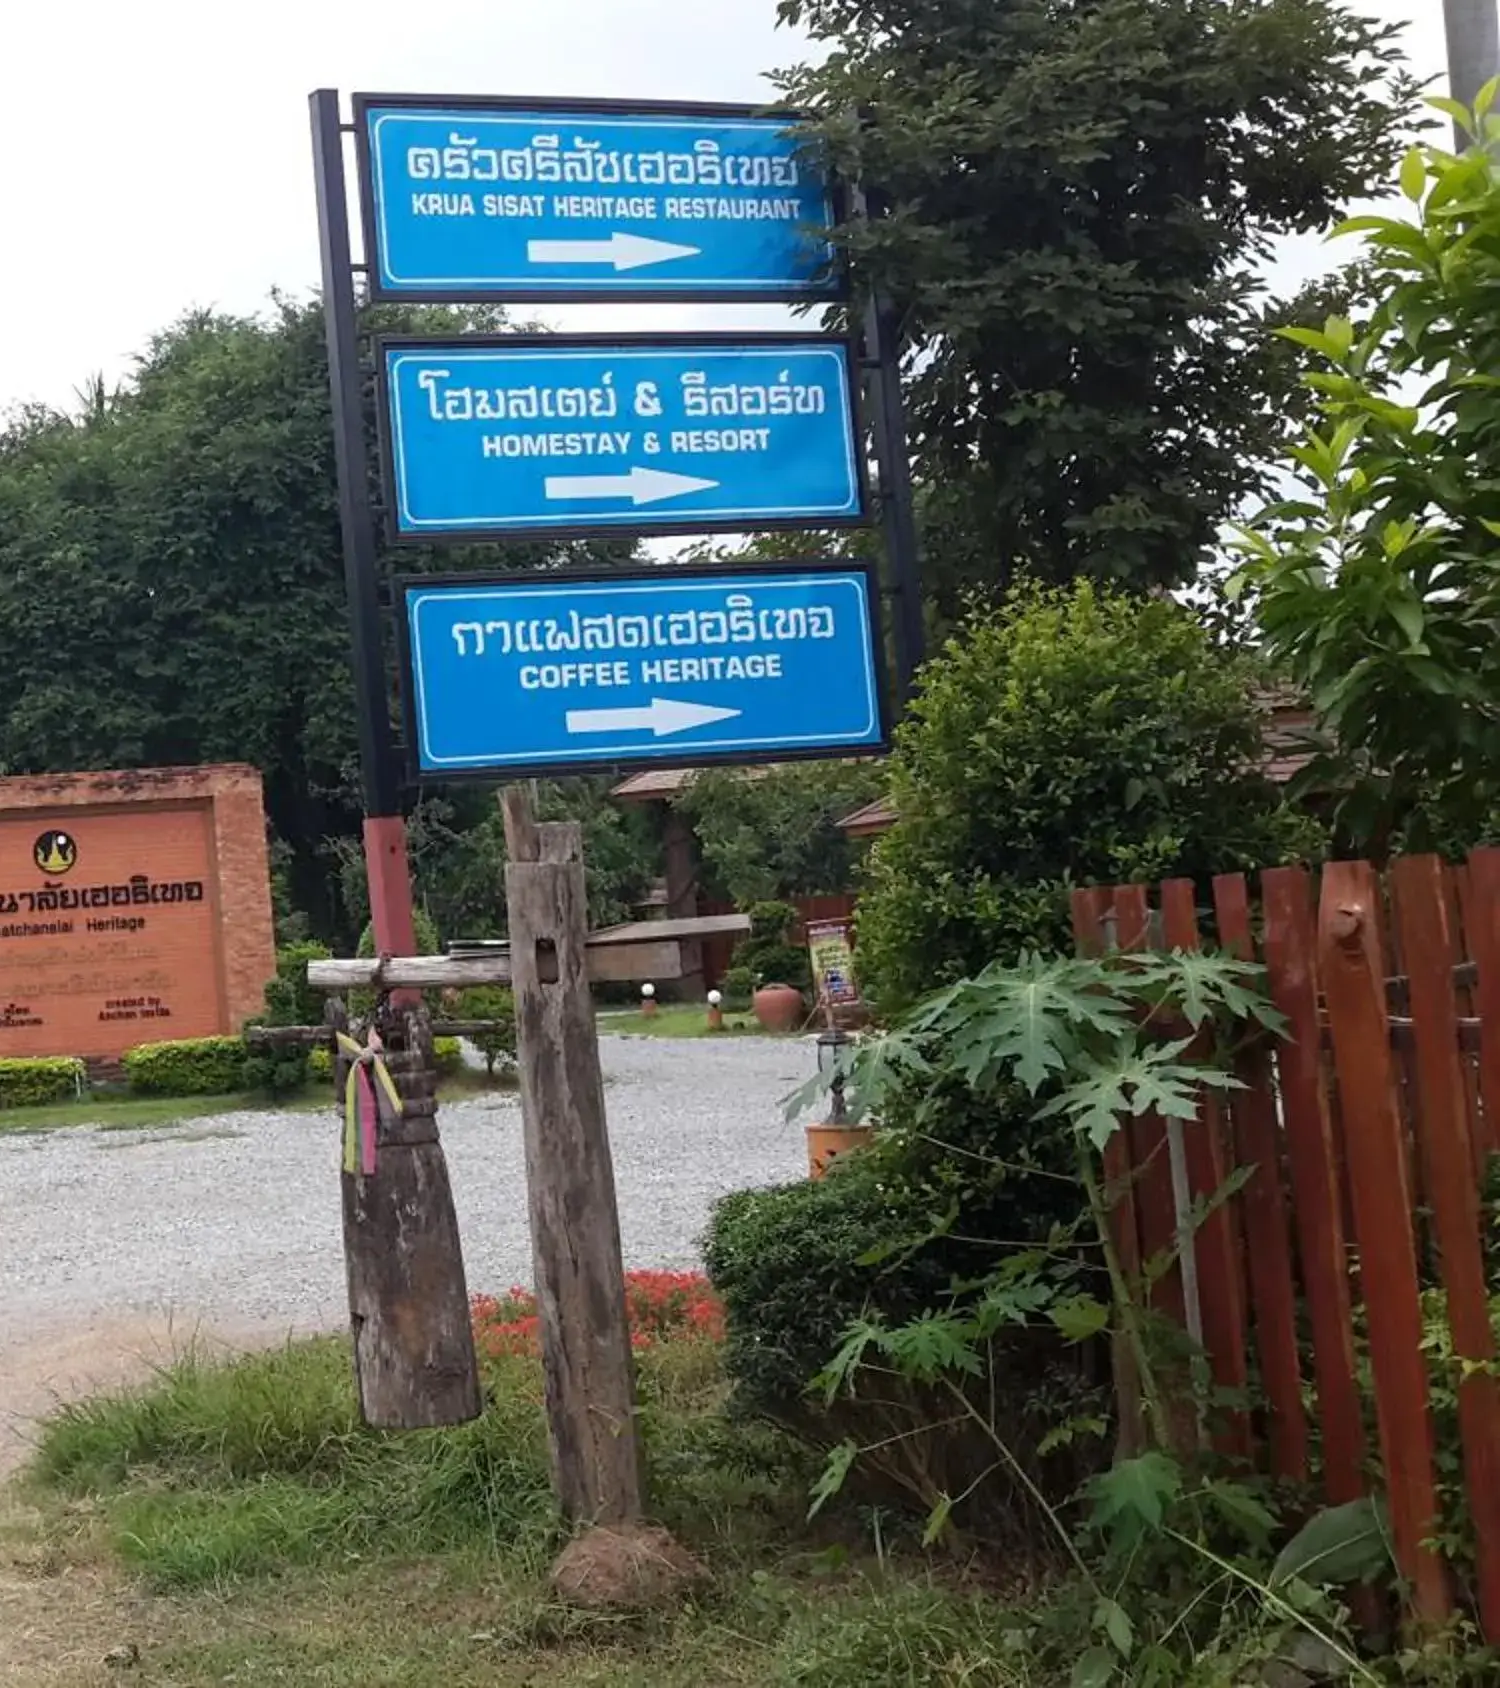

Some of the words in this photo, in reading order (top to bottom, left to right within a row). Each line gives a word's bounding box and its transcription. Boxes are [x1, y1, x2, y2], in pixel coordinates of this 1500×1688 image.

[412, 194, 475, 216] KRUA
[483, 194, 545, 217] SISAT
[554, 195, 657, 219] HERITAGE
[666, 196, 801, 220] RESTAURANT
[418, 369, 617, 421] โฮมสเตย์
[635, 381, 663, 417] &
[681, 369, 825, 416] รีสอร์ท
[482, 431, 631, 458] HOMESTAY
[643, 431, 661, 454] &
[671, 428, 771, 454] RESORT
[451, 594, 836, 656] กาแฟสดเฮอริเทจ
[519, 660, 631, 690] COFFEE
[641, 653, 783, 684] HERITAGE
[86, 914, 146, 934] Heritage
